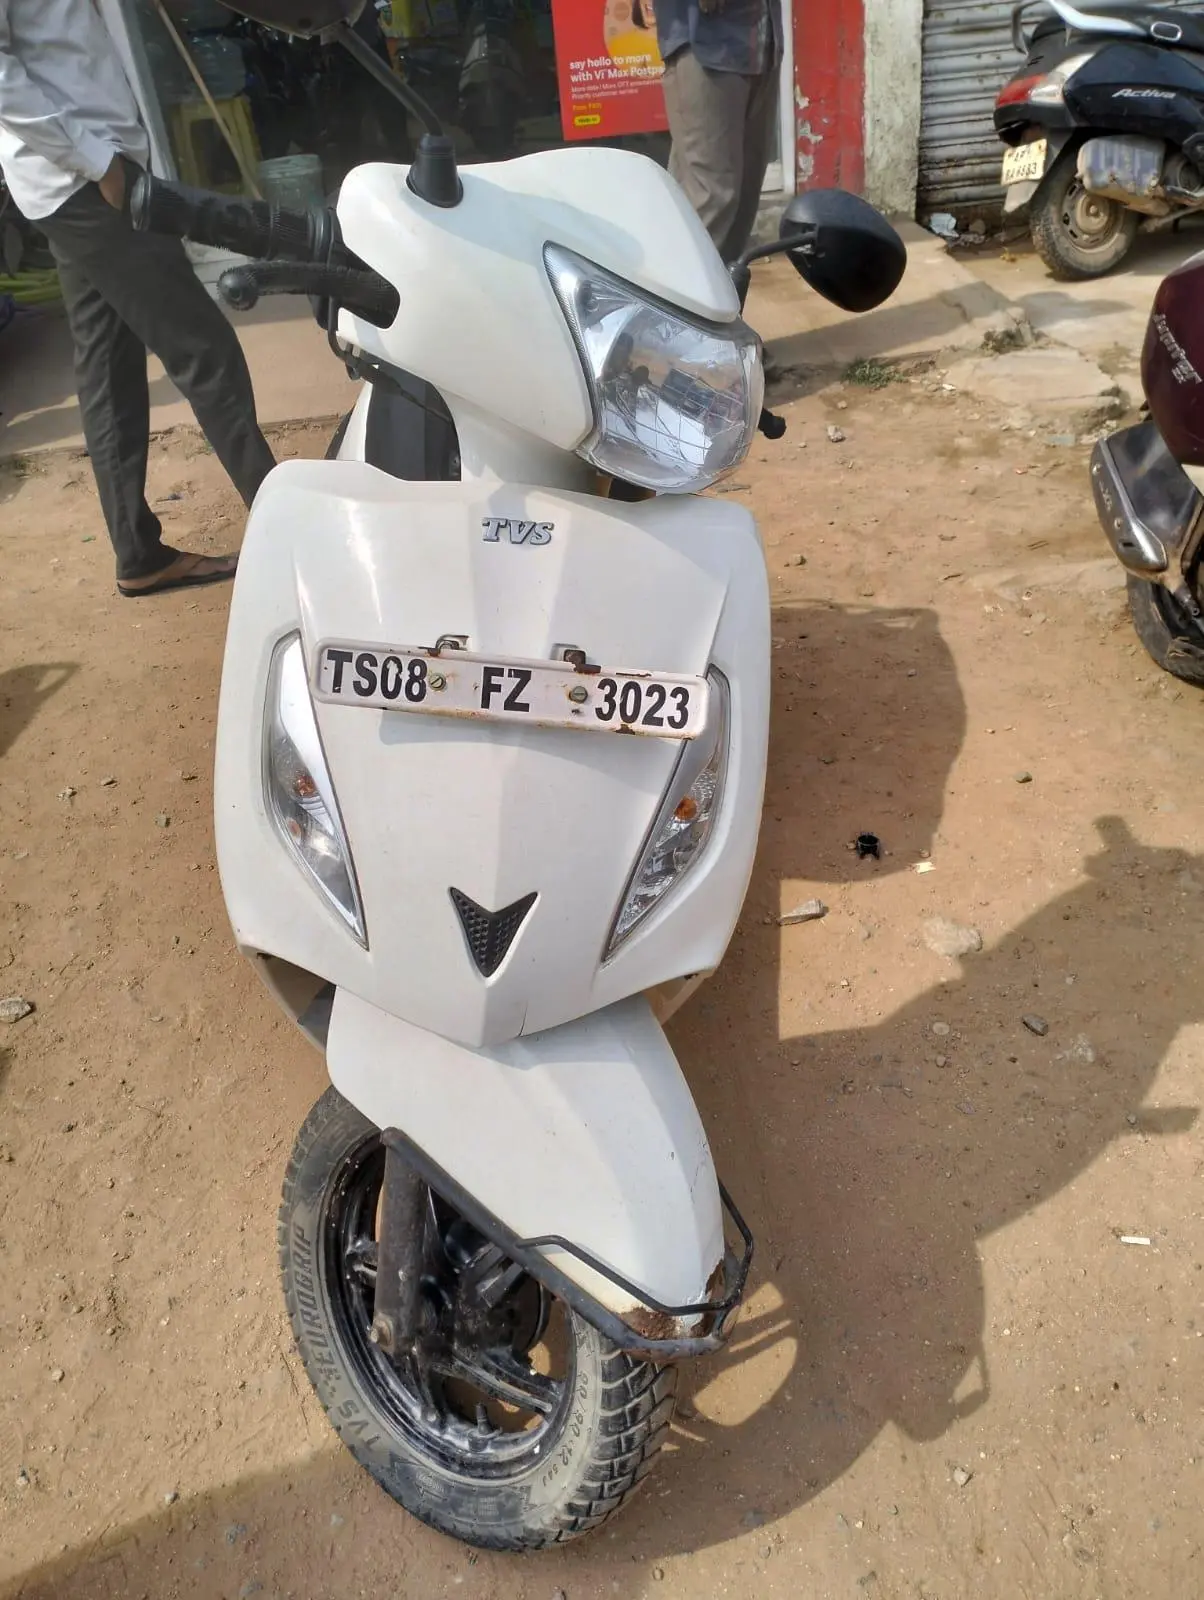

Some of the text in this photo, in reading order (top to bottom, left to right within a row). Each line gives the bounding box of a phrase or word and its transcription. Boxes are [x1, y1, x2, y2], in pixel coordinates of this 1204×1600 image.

[570, 54, 652, 71] say hello to more
[570, 71, 593, 82] with
[608, 68, 629, 79] Max
[631, 65, 665, 78] Postpa
[1111, 88, 1176, 98] Activa
[481, 517, 555, 546] TVS
[326, 650, 690, 729] TS08 FZ 3023
[291, 1226, 381, 1451] TVS EUROGRIP
